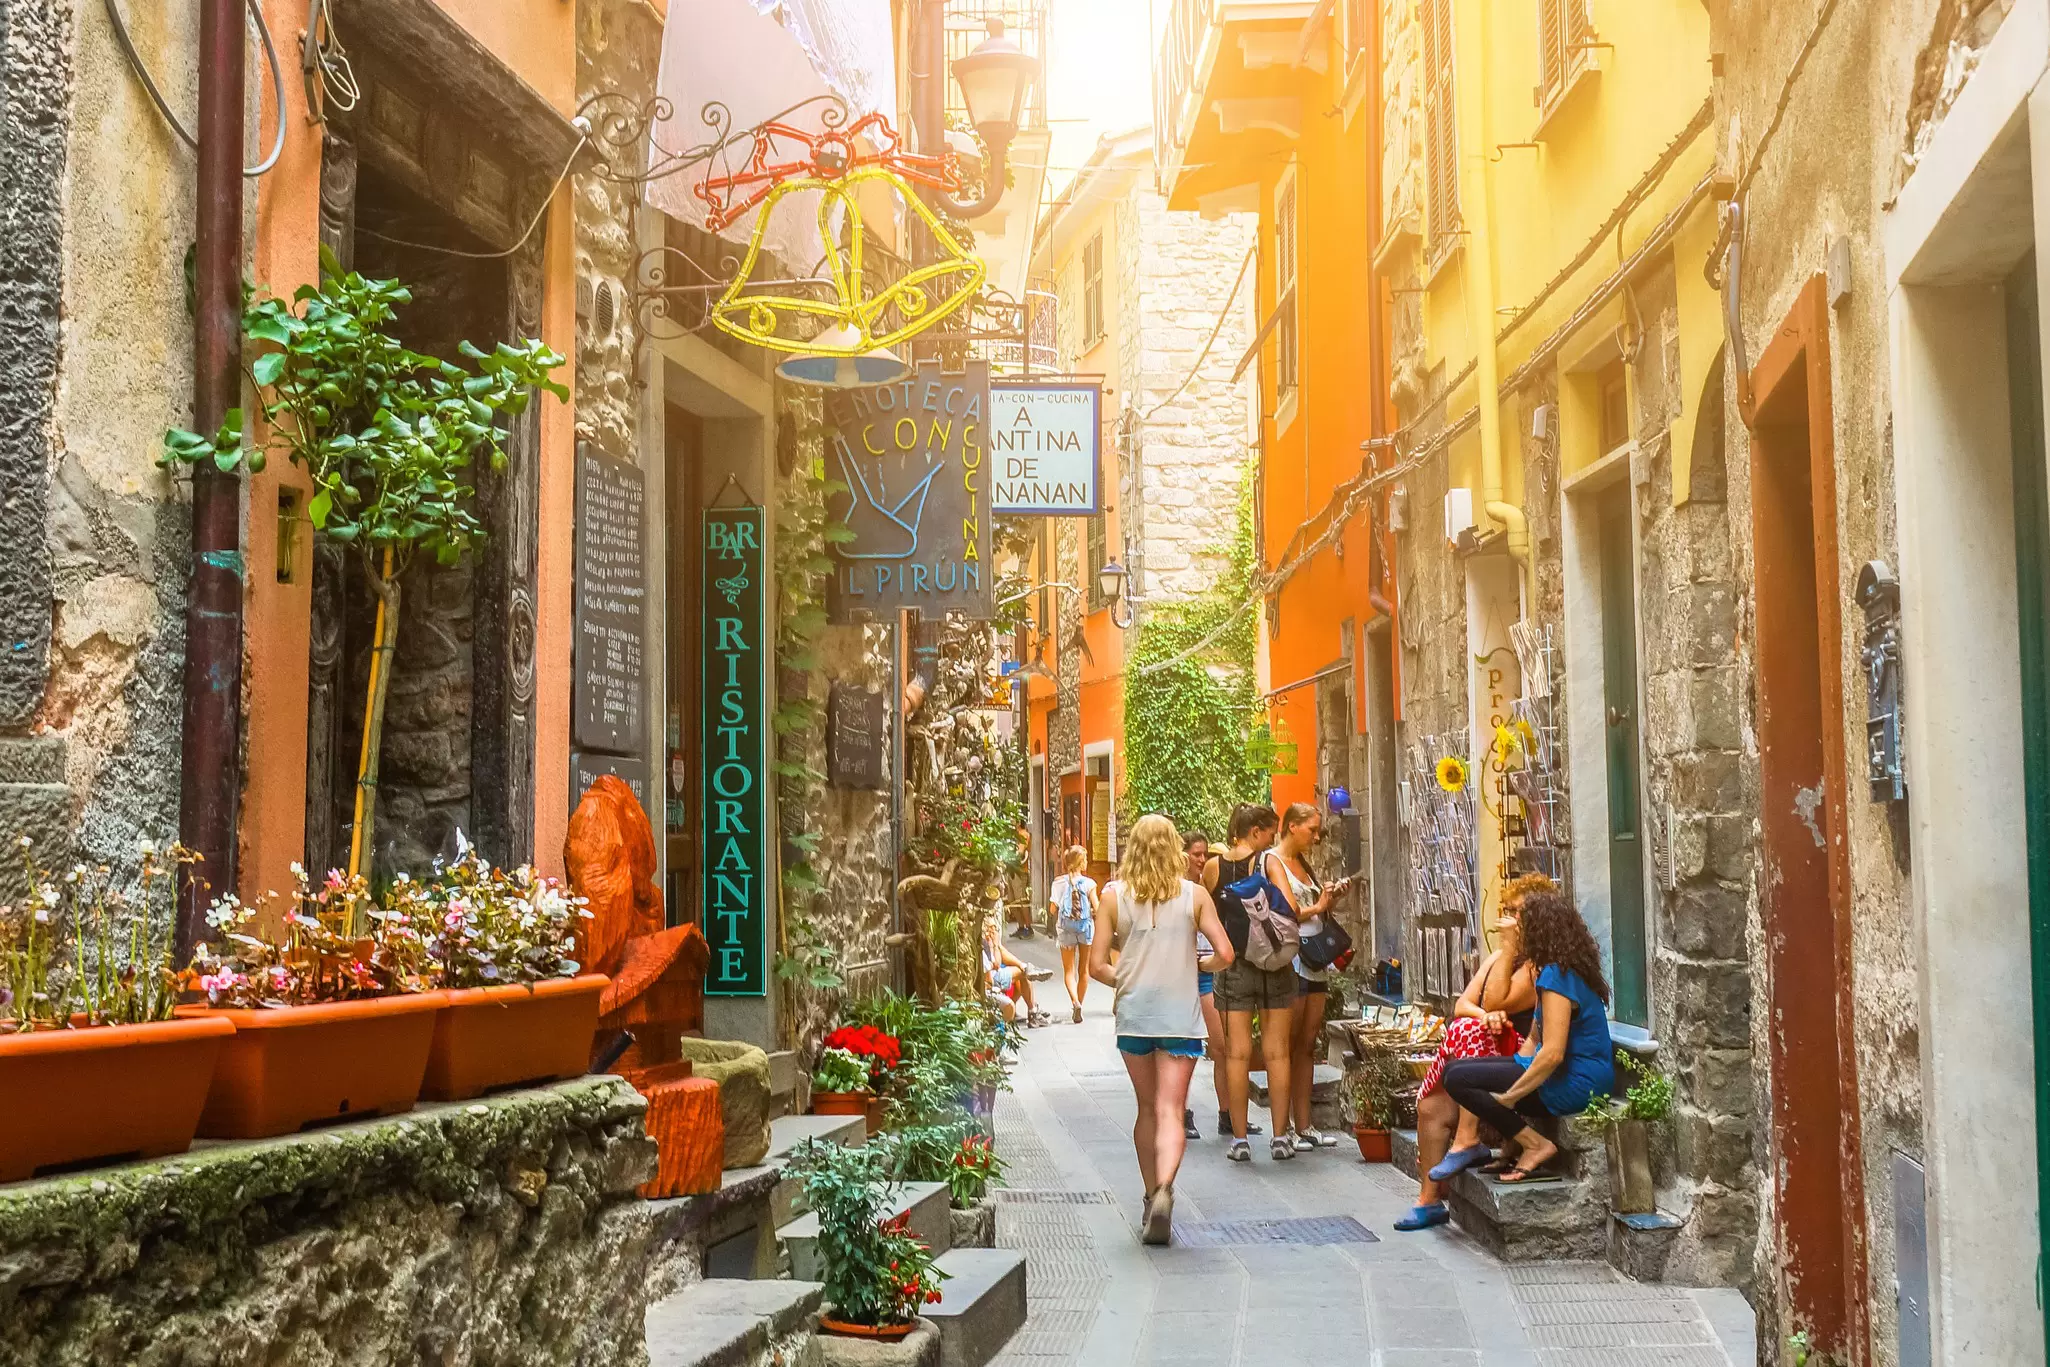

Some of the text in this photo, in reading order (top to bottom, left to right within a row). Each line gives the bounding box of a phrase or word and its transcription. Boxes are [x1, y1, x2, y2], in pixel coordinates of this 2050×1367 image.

[829, 381, 980, 427] ENOTECA
[1047, 393, 1089, 404] CUCINA
[862, 416, 952, 456] CON
[991, 430, 1081, 451] NTINA
[1007, 457, 1039, 479] DE
[961, 425, 981, 561] CUCINA
[991, 482, 1086, 504] NANAN
[708, 521, 760, 560] BAR
[713, 617, 753, 981] RISTORANTE
